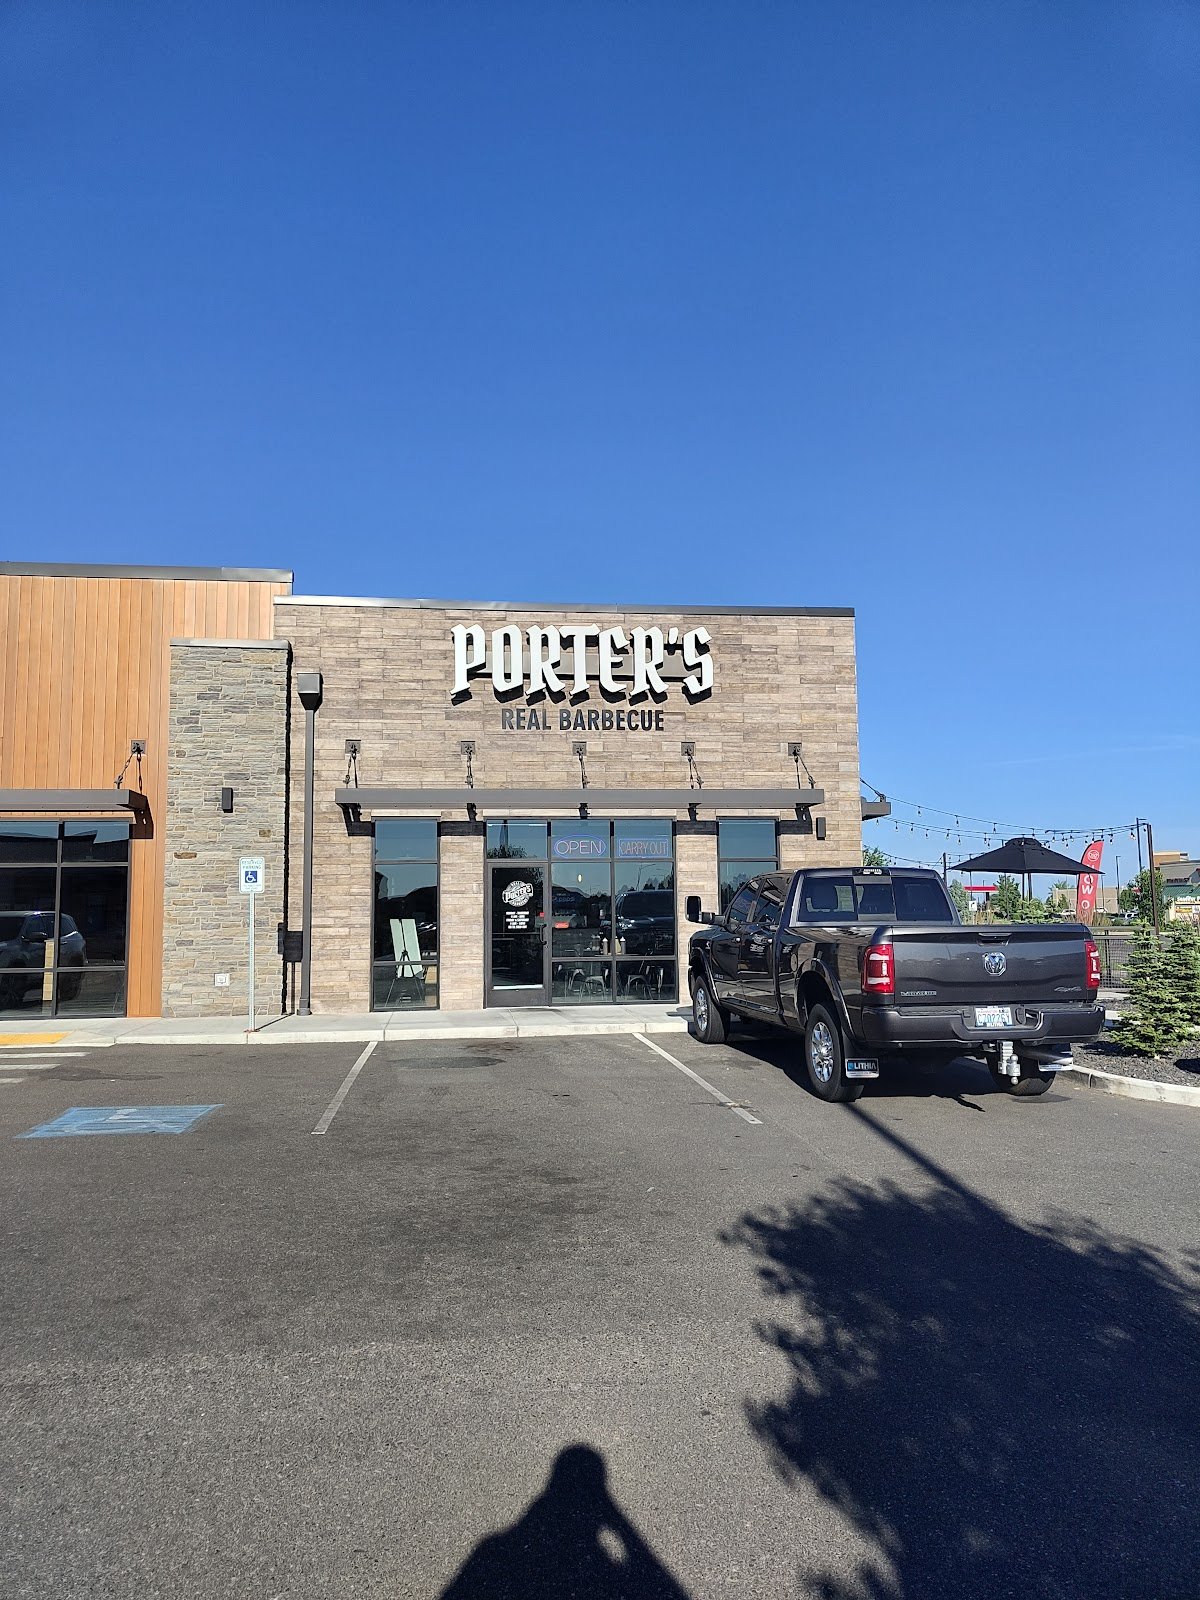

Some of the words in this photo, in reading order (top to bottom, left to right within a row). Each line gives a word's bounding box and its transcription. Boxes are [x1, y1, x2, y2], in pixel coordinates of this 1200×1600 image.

[450, 623, 714, 697] PORTER'S
[501, 708, 552, 730] REAL
[559, 709, 665, 731] BARBECUE
[556, 840, 602, 855] OPEN
[620, 841, 650, 855] CARRY
[650, 841, 667, 855] OUT
[854, 1062, 877, 1070] LITHIA
